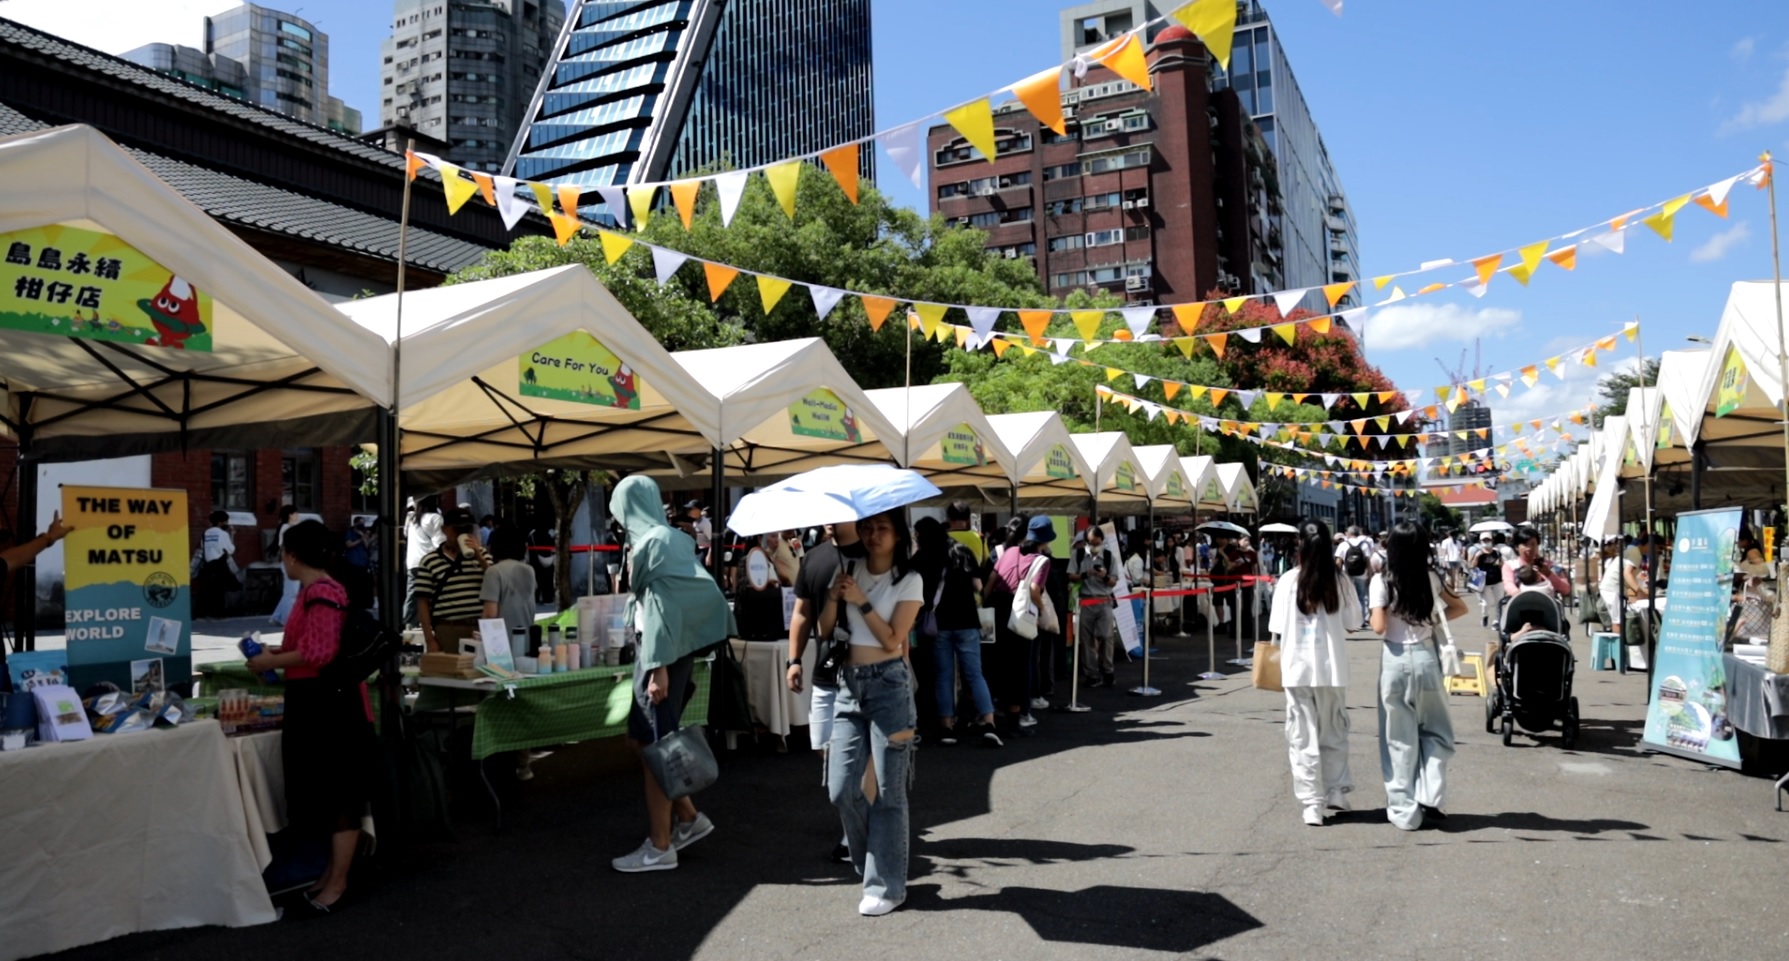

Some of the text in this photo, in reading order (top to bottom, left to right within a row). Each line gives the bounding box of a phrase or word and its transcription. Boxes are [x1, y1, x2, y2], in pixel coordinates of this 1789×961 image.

[5, 241, 122, 280] 島島永續
[15, 276, 102, 309] 柑仔店
[531, 351, 609, 376] Care For You
[76, 497, 173, 515] THE WAY
[107, 524, 136, 540] OF
[88, 549, 163, 564] MATSU
[65, 607, 142, 623] EXPLORE
[66, 626, 124, 641] WORLD
